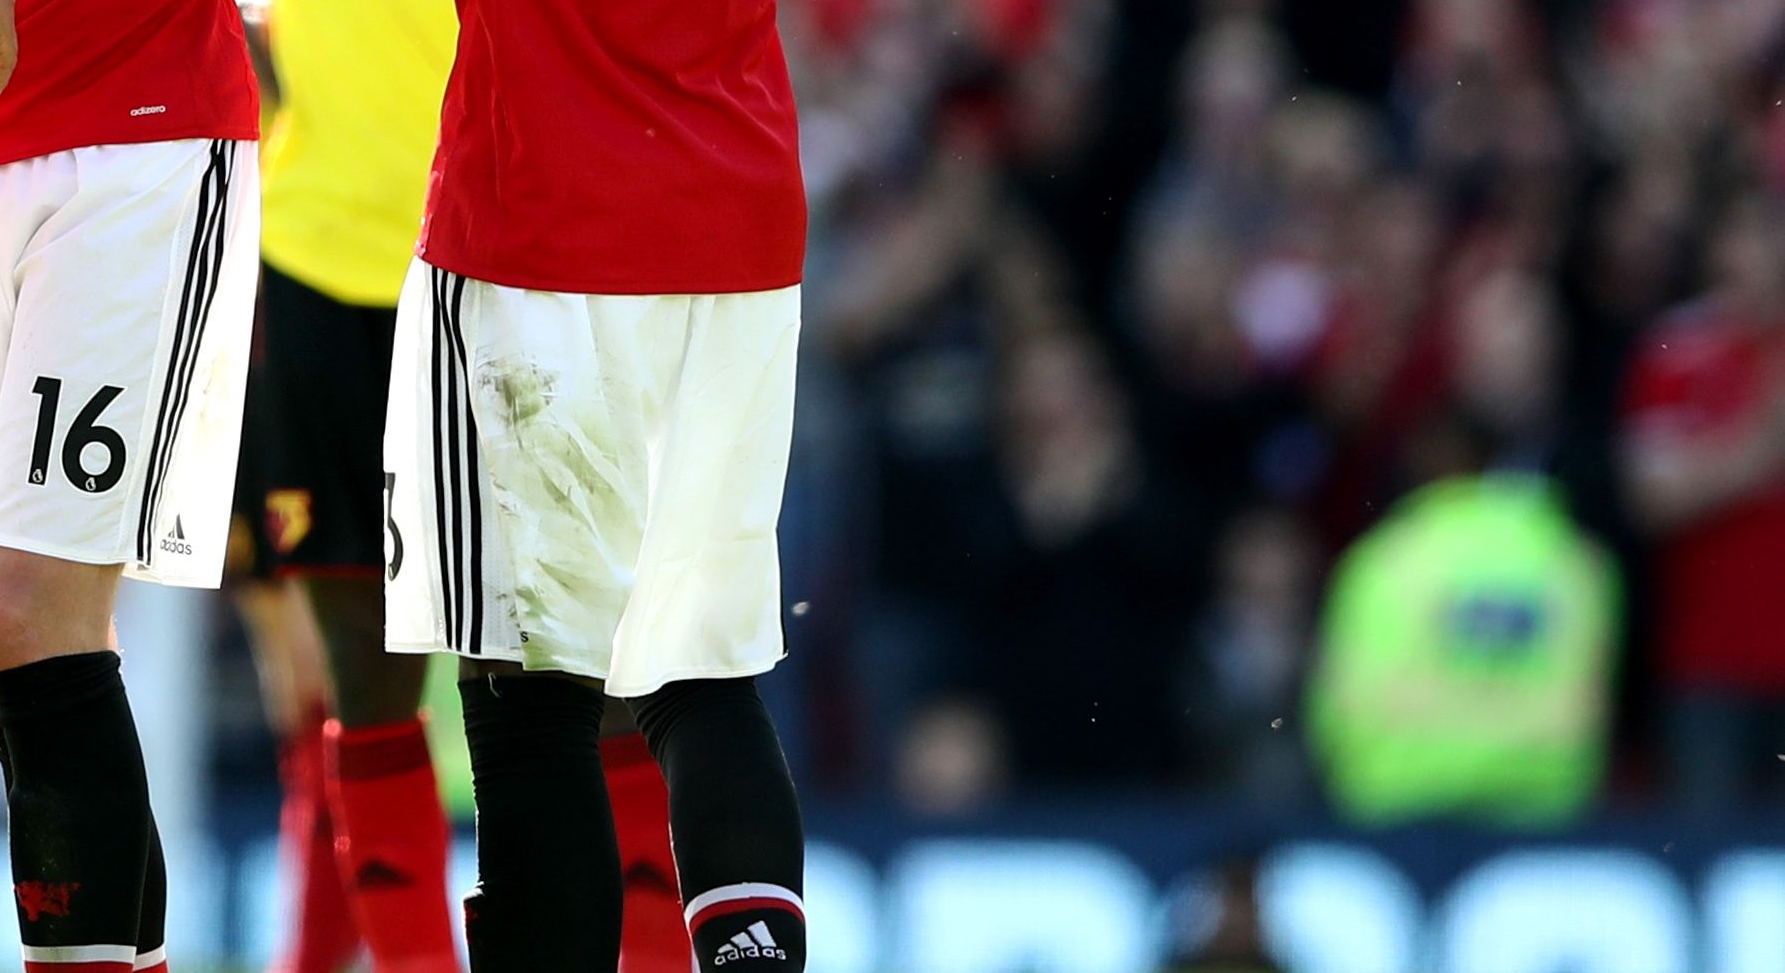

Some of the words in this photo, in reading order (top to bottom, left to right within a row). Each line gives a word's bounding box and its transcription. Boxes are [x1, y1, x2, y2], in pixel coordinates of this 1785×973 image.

[26, 374, 128, 494] 16
[159, 538, 193, 556] addas
[714, 944, 787, 966] adidas
